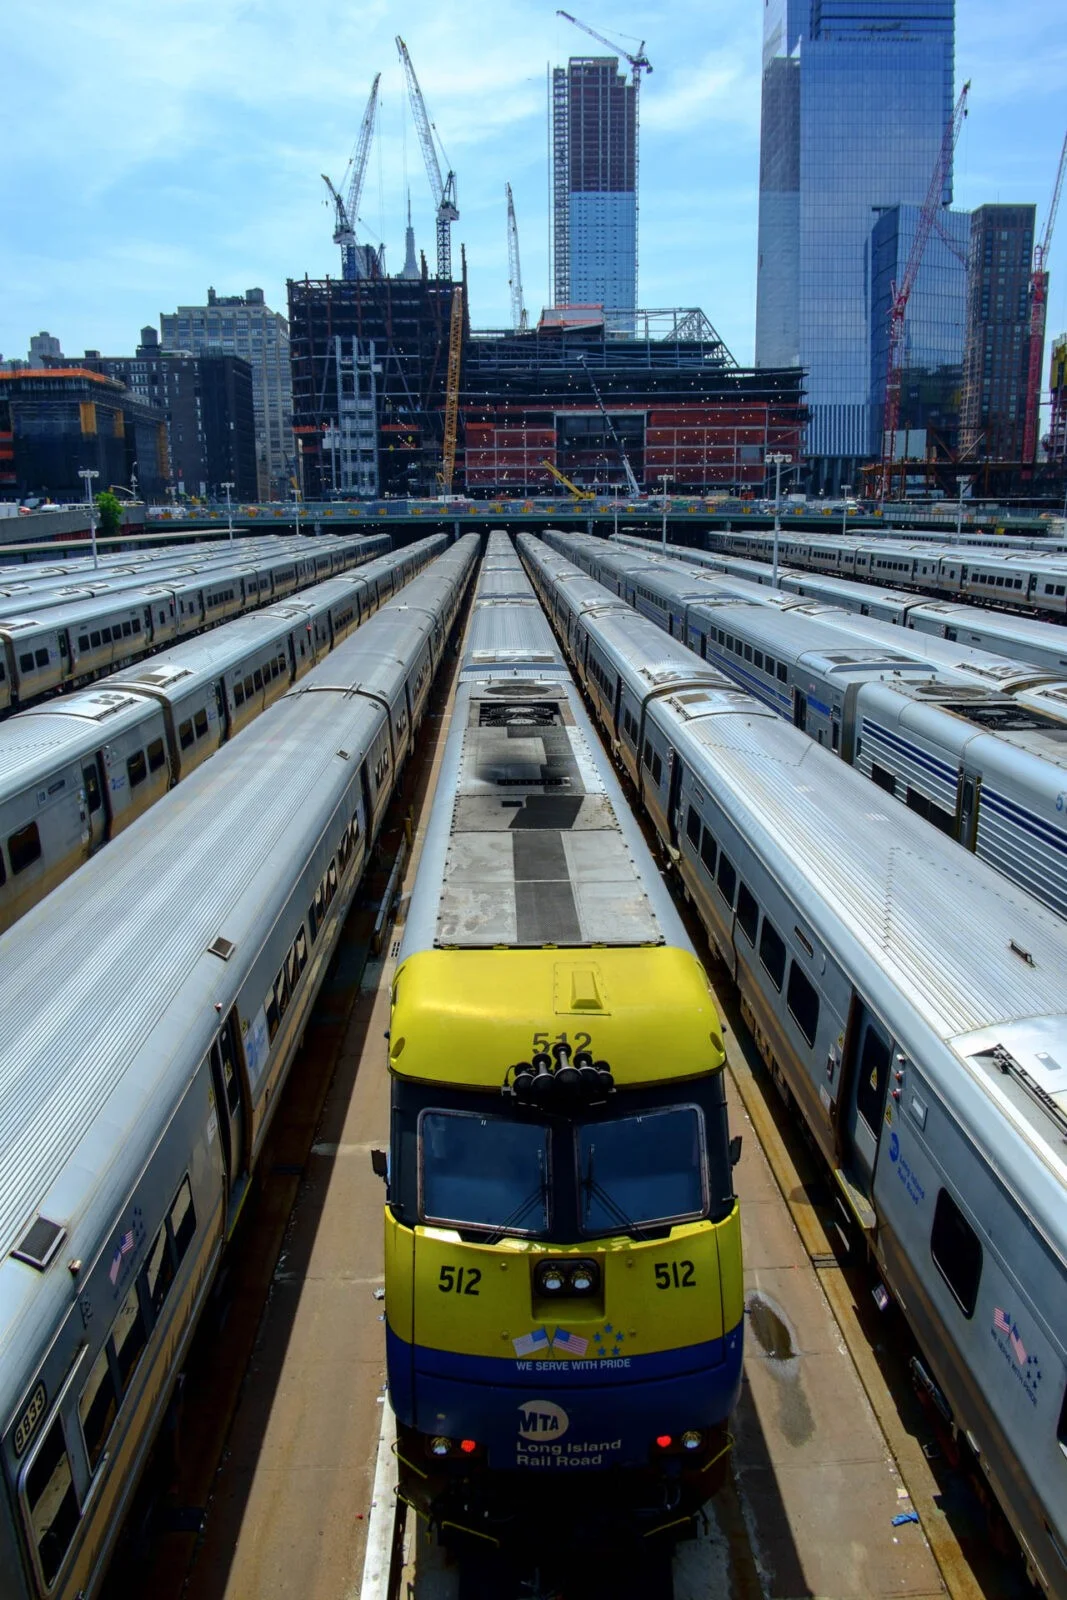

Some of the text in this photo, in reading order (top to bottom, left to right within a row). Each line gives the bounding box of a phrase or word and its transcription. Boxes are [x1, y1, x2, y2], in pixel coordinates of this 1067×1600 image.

[532, 1032, 593, 1055] 512
[438, 1265, 482, 1295] 512
[654, 1260, 696, 1289] 512
[516, 1358, 631, 1371] WE SERVE WITH PRIDE
[15, 1385, 44, 1450] 9833
[519, 1408, 560, 1433] MTA
[516, 1439, 622, 1456] Long Island
[516, 1454, 602, 1467] Rail Road
